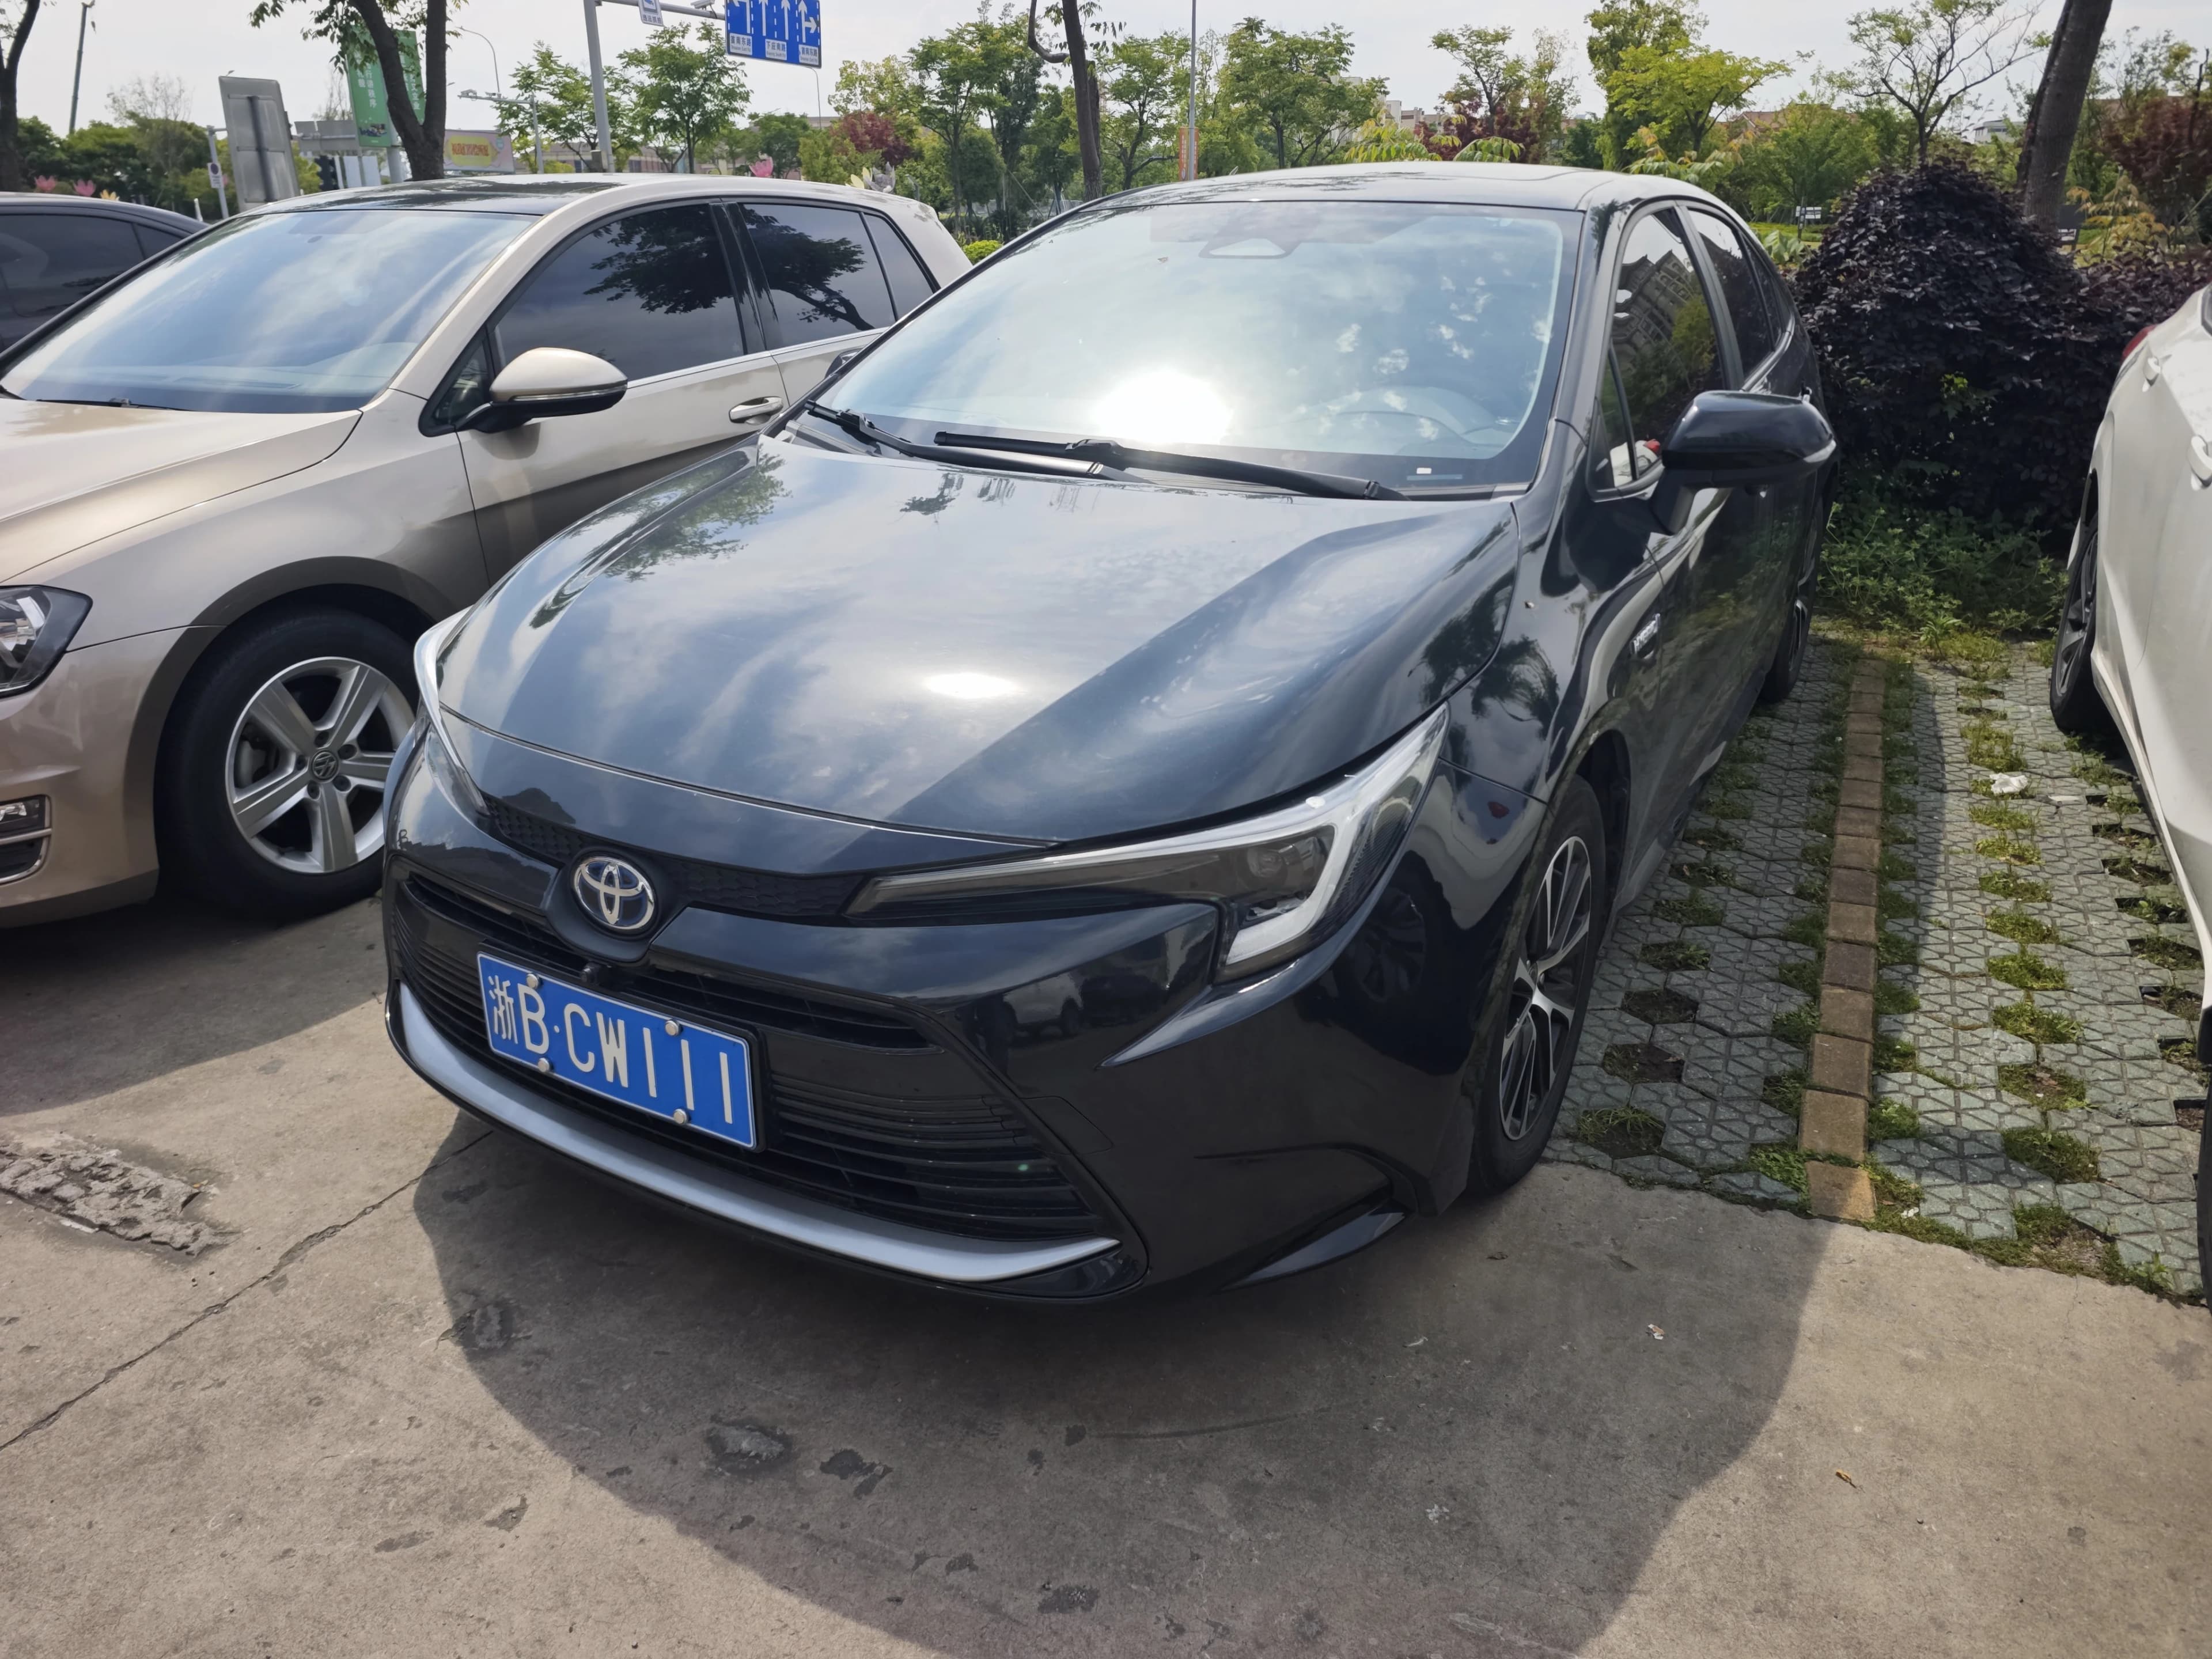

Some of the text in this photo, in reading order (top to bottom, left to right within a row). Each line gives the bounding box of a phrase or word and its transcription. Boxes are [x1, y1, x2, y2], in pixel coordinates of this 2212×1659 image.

[731, 36, 751, 47] 首南东路
[766, 41, 786, 52] 下应南路
